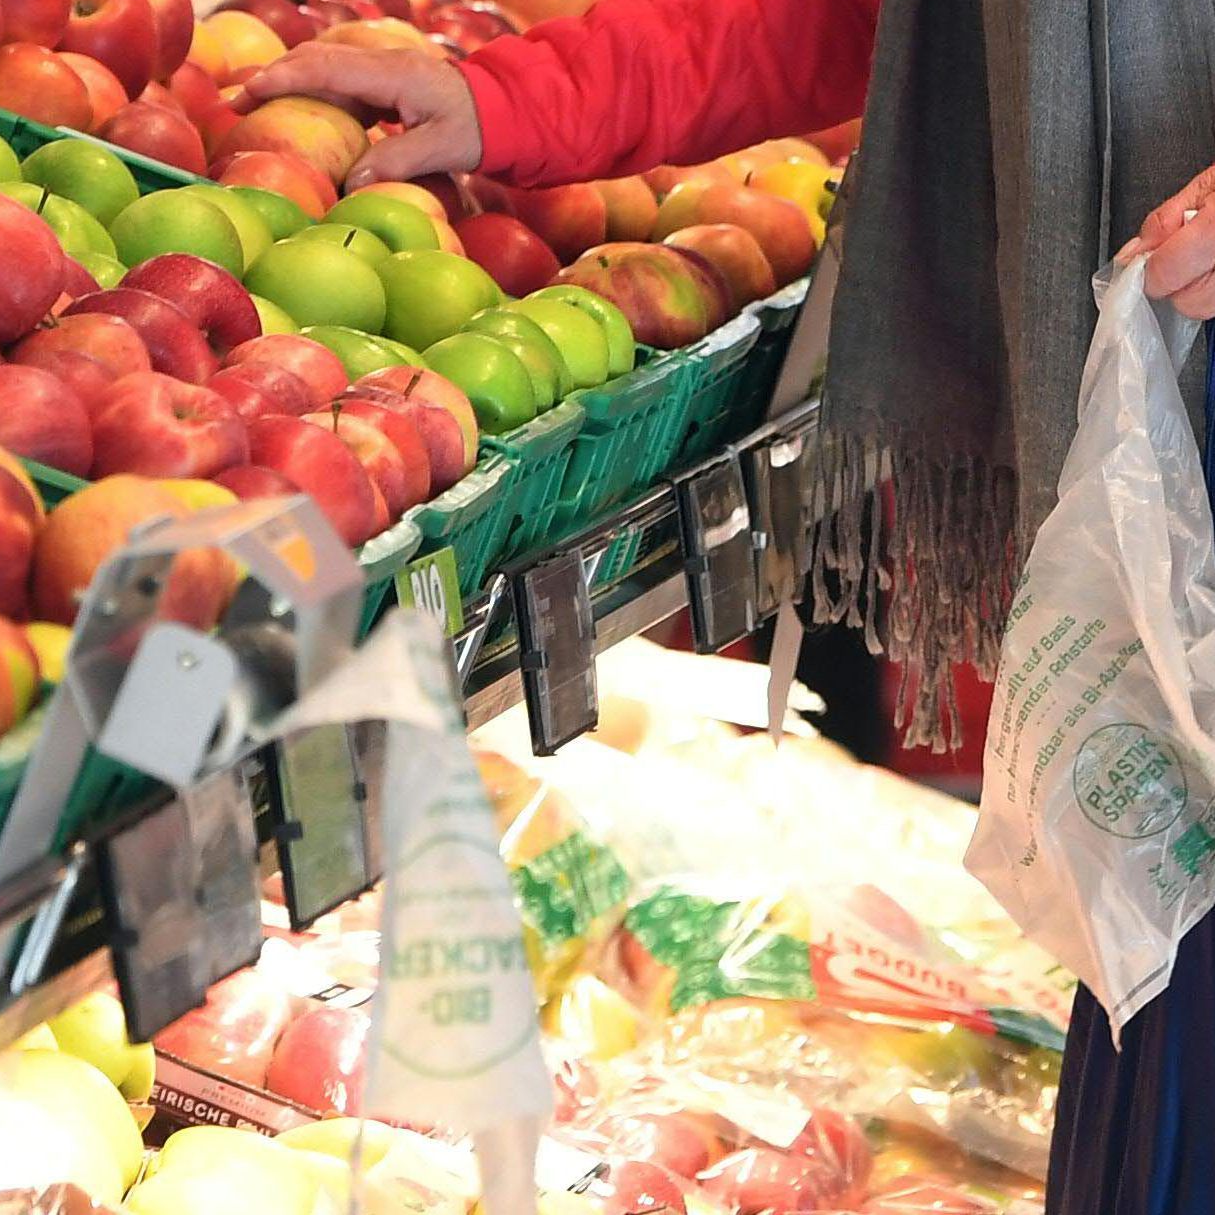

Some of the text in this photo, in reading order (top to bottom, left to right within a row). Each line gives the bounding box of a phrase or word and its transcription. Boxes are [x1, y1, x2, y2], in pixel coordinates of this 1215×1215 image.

[1022, 646, 1043, 673] auf
[1039, 615, 1077, 652] Basis
[1063, 702, 1087, 728] als
[1086, 732, 1158, 810] PLASTIK
[1103, 751, 1173, 823] SPAREN
[389, 936, 524, 980] ACKER
[150, 1084, 232, 1126] EIRISCHE
